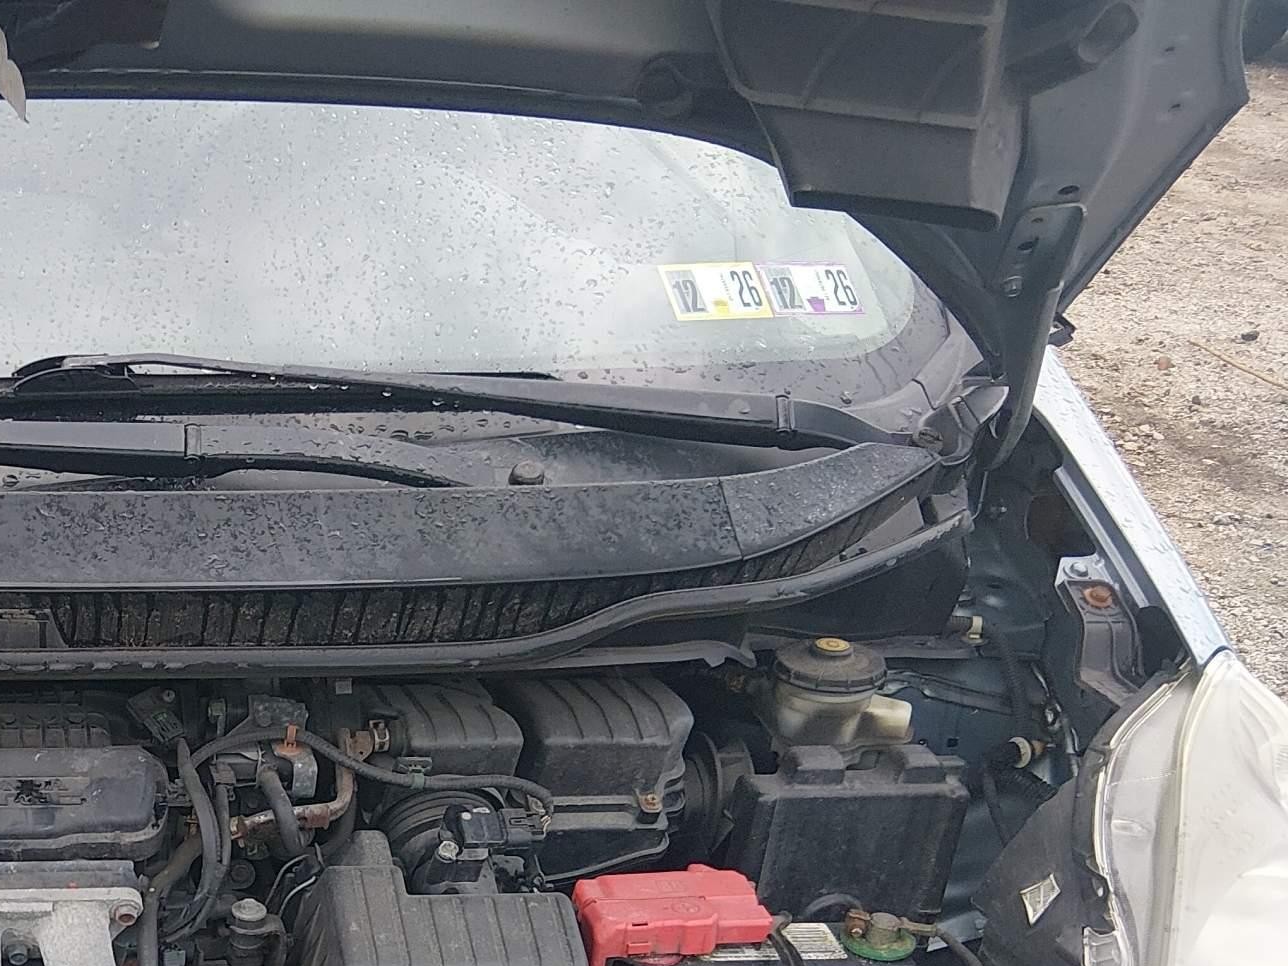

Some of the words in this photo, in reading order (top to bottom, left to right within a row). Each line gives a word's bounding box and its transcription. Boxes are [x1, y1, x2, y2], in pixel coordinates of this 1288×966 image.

[672, 279, 706, 313] 12
[729, 270, 763, 307] 26
[769, 276, 803, 309] 12
[824, 269, 858, 305] 26
